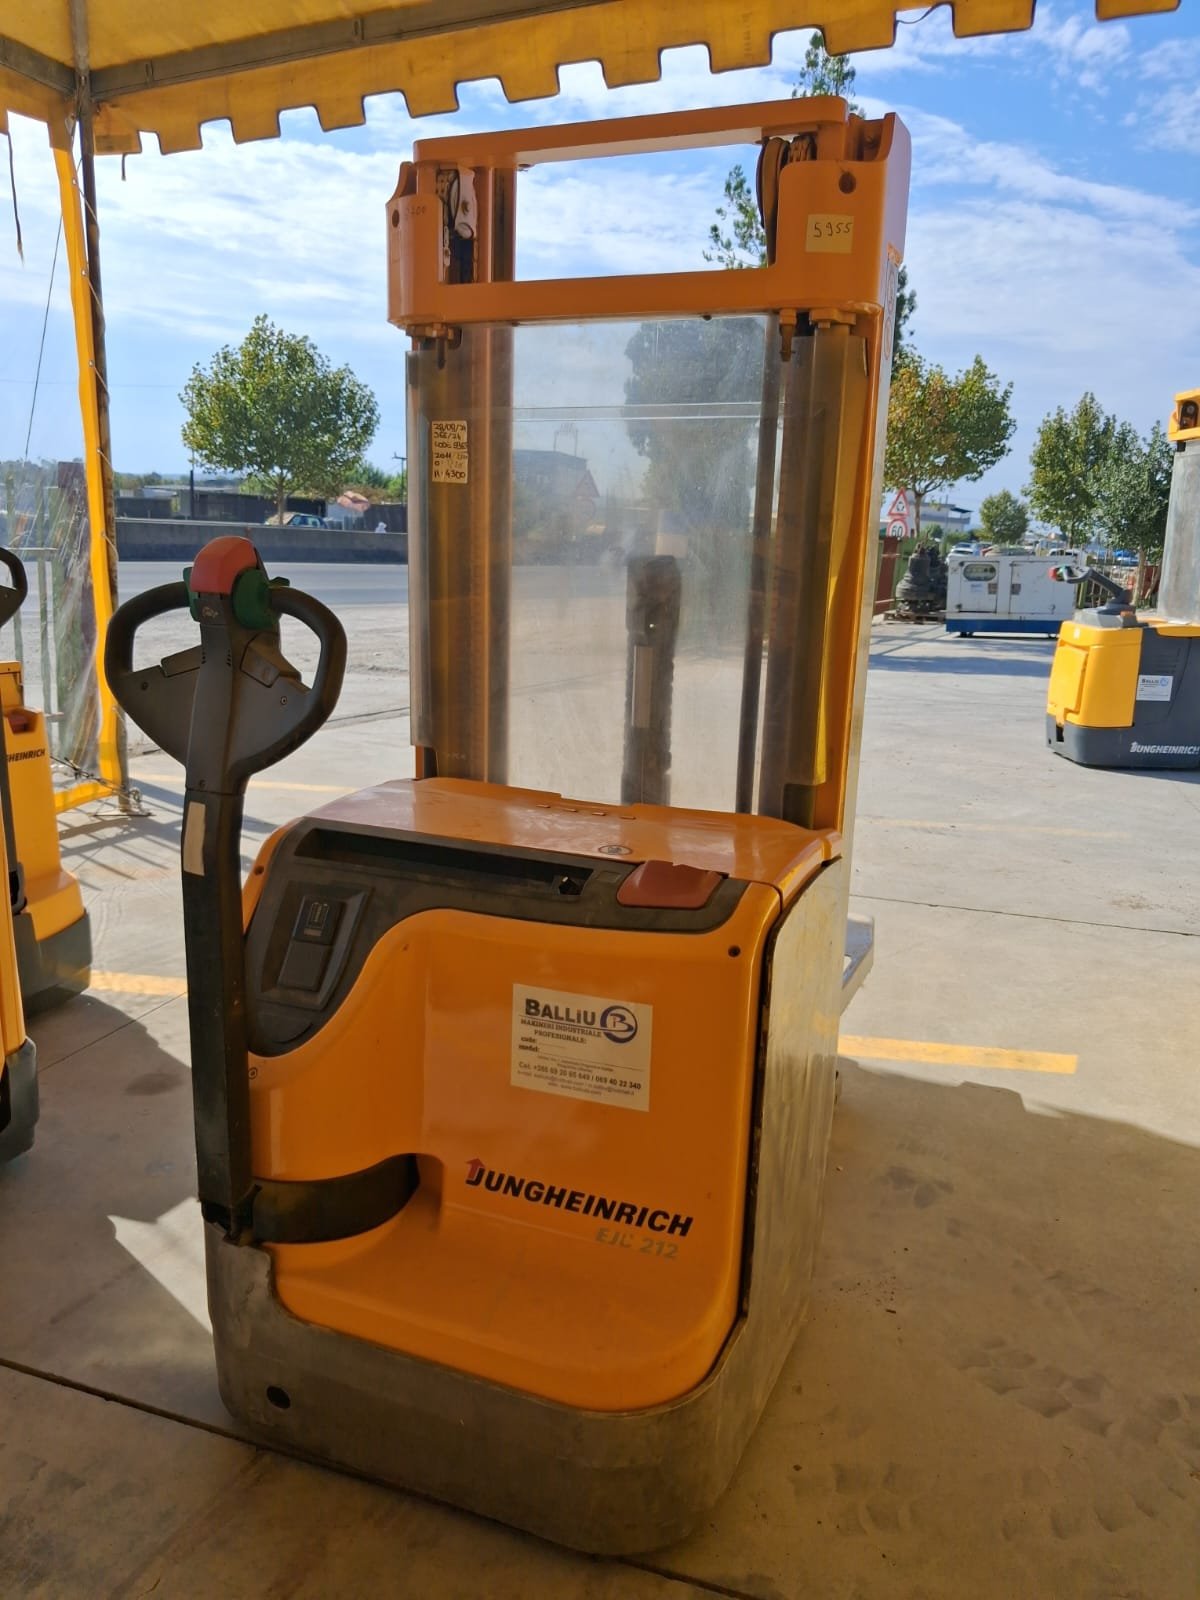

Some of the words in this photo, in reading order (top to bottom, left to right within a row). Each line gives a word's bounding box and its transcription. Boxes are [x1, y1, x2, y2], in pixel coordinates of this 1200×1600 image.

[813, 221, 853, 238] 5955
[891, 525, 903, 538] 60
[7, 749, 45, 762] HEINRICH
[629, 1081, 642, 1090] 340
[465, 1165, 694, 1237] JUNGHEINRICH
[639, 1238, 679, 1260] 212
